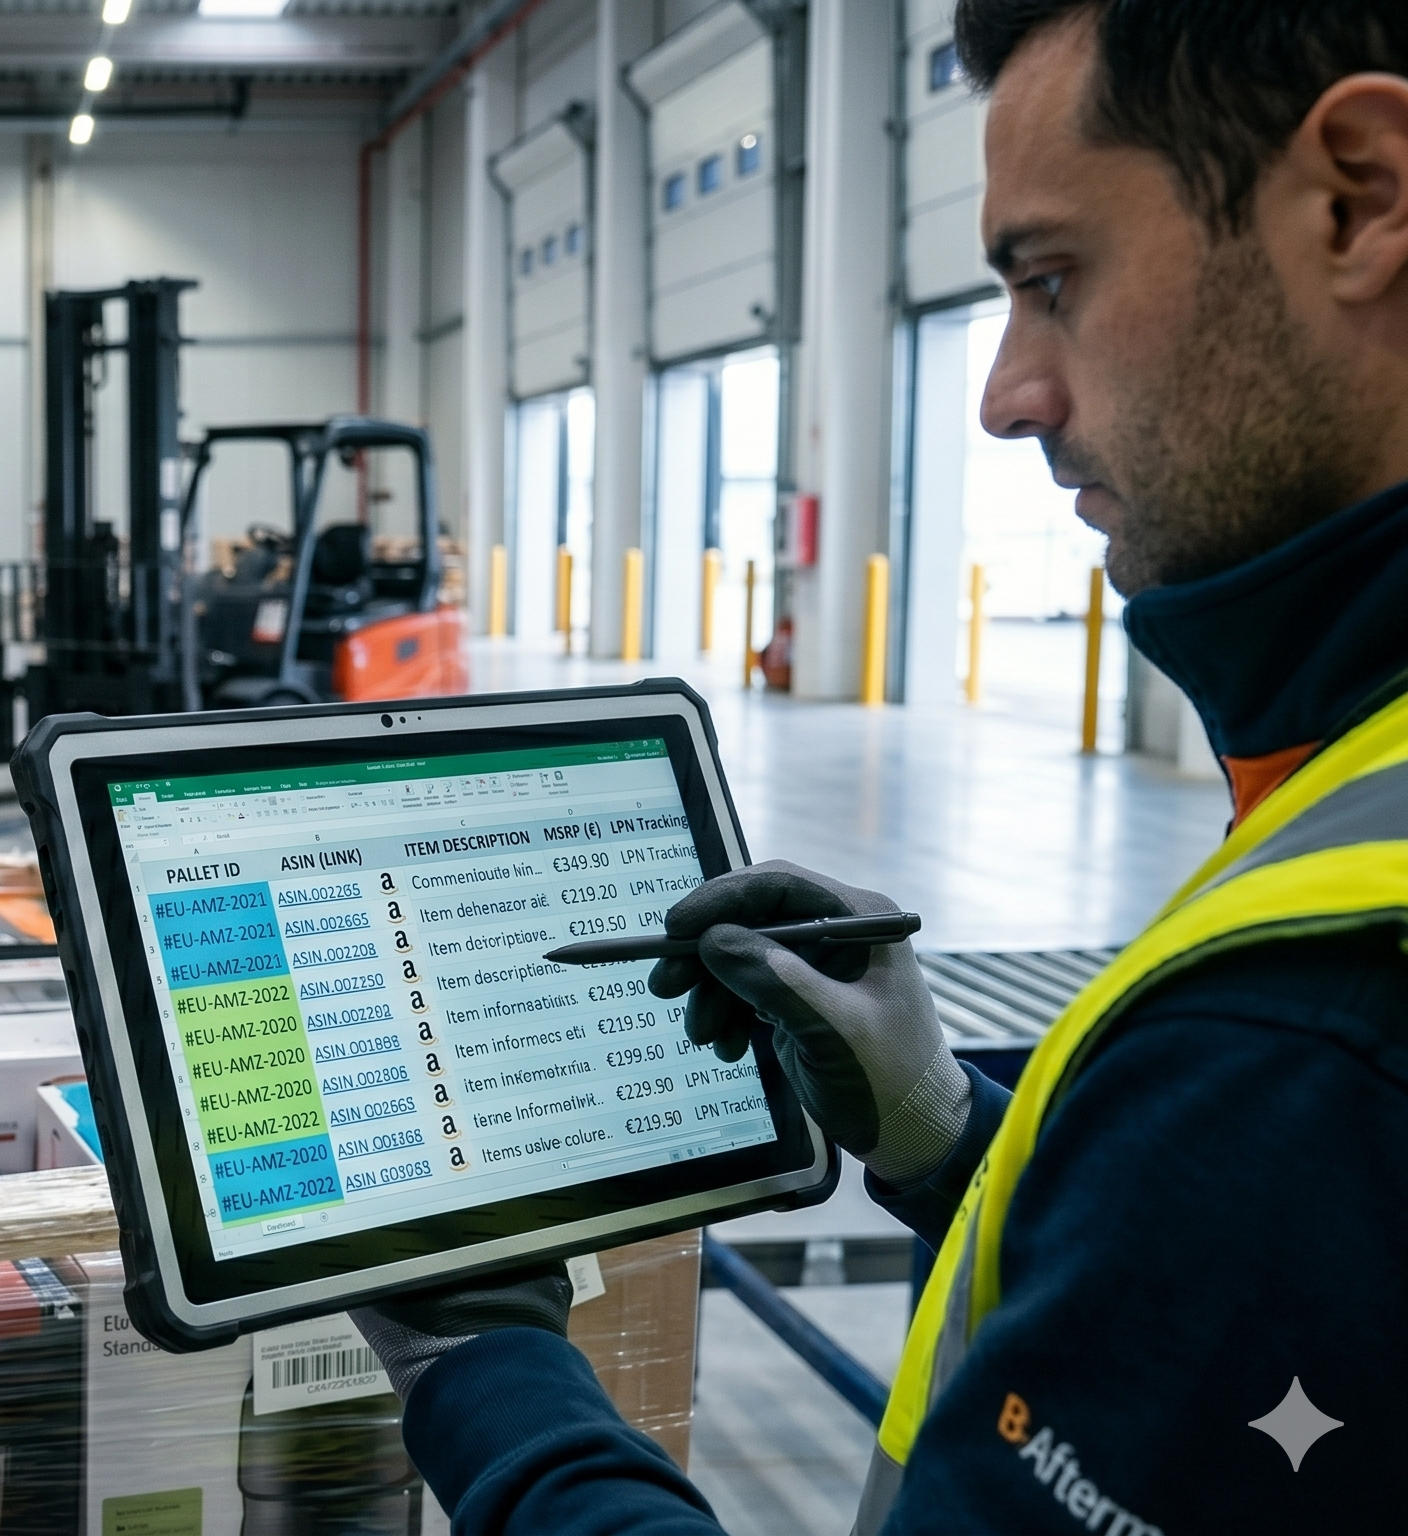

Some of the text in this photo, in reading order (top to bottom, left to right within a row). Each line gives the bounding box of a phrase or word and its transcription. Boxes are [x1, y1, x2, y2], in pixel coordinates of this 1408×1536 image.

[543, 821, 602, 841] MSRP (€)
[610, 813, 689, 834] LPN Tracking
[315, 834, 321, 842] B
[404, 830, 531, 857] ITEM DESCRIPTION
[280, 847, 363, 872] ASIN (LINK)
[620, 844, 698, 865] LPN Tracking
[166, 862, 241, 884] PALLET ID
[380, 872, 395, 890] a
[561, 883, 618, 905] €219.20
[629, 879, 655, 896] LPN
[155, 891, 267, 918] #EU-AMZ-2021
[387, 901, 403, 919] a
[420, 908, 453, 923] Item
[569, 914, 627, 937] €219.50
[638, 910, 664, 927] LPN
[163, 922, 276, 950] #EU-AMZ-2021
[394, 930, 410, 949] a
[428, 942, 462, 957] Item
[170, 954, 282, 982] #EU-AMZ-2021
[402, 959, 418, 979] a
[437, 976, 471, 991] Item
[588, 979, 646, 1002] €249.90
[177, 985, 290, 1014] #EU-AMZ-2022
[410, 990, 425, 1010] a
[446, 1009, 480, 1024] Item
[597, 1011, 656, 1035] €219.50
[185, 1015, 297, 1047] #EU-AMZ-2020
[418, 1021, 433, 1041] a
[454, 1044, 489, 1059] Item
[193, 1046, 305, 1079] #EU-AMZ-2020
[425, 1052, 441, 1072] a
[685, 1063, 761, 1088] LPN Tracking
[200, 1078, 312, 1112] #EU-AMZ-2020
[433, 1083, 449, 1103] a
[330, 1107, 361, 1125] ASIN
[694, 1095, 770, 1121] LPN Tracking
[207, 1110, 320, 1145] #EU-AMZ-2022
[442, 1115, 458, 1135] a
[625, 1110, 683, 1135] €219.50
[215, 1143, 328, 1180] #EU-AMZ-2020
[450, 1146, 466, 1166] a
[482, 1145, 522, 1163] Items
[346, 1171, 377, 1190] ASIN
[222, 1176, 336, 1213] #EU-AMZ-2022
